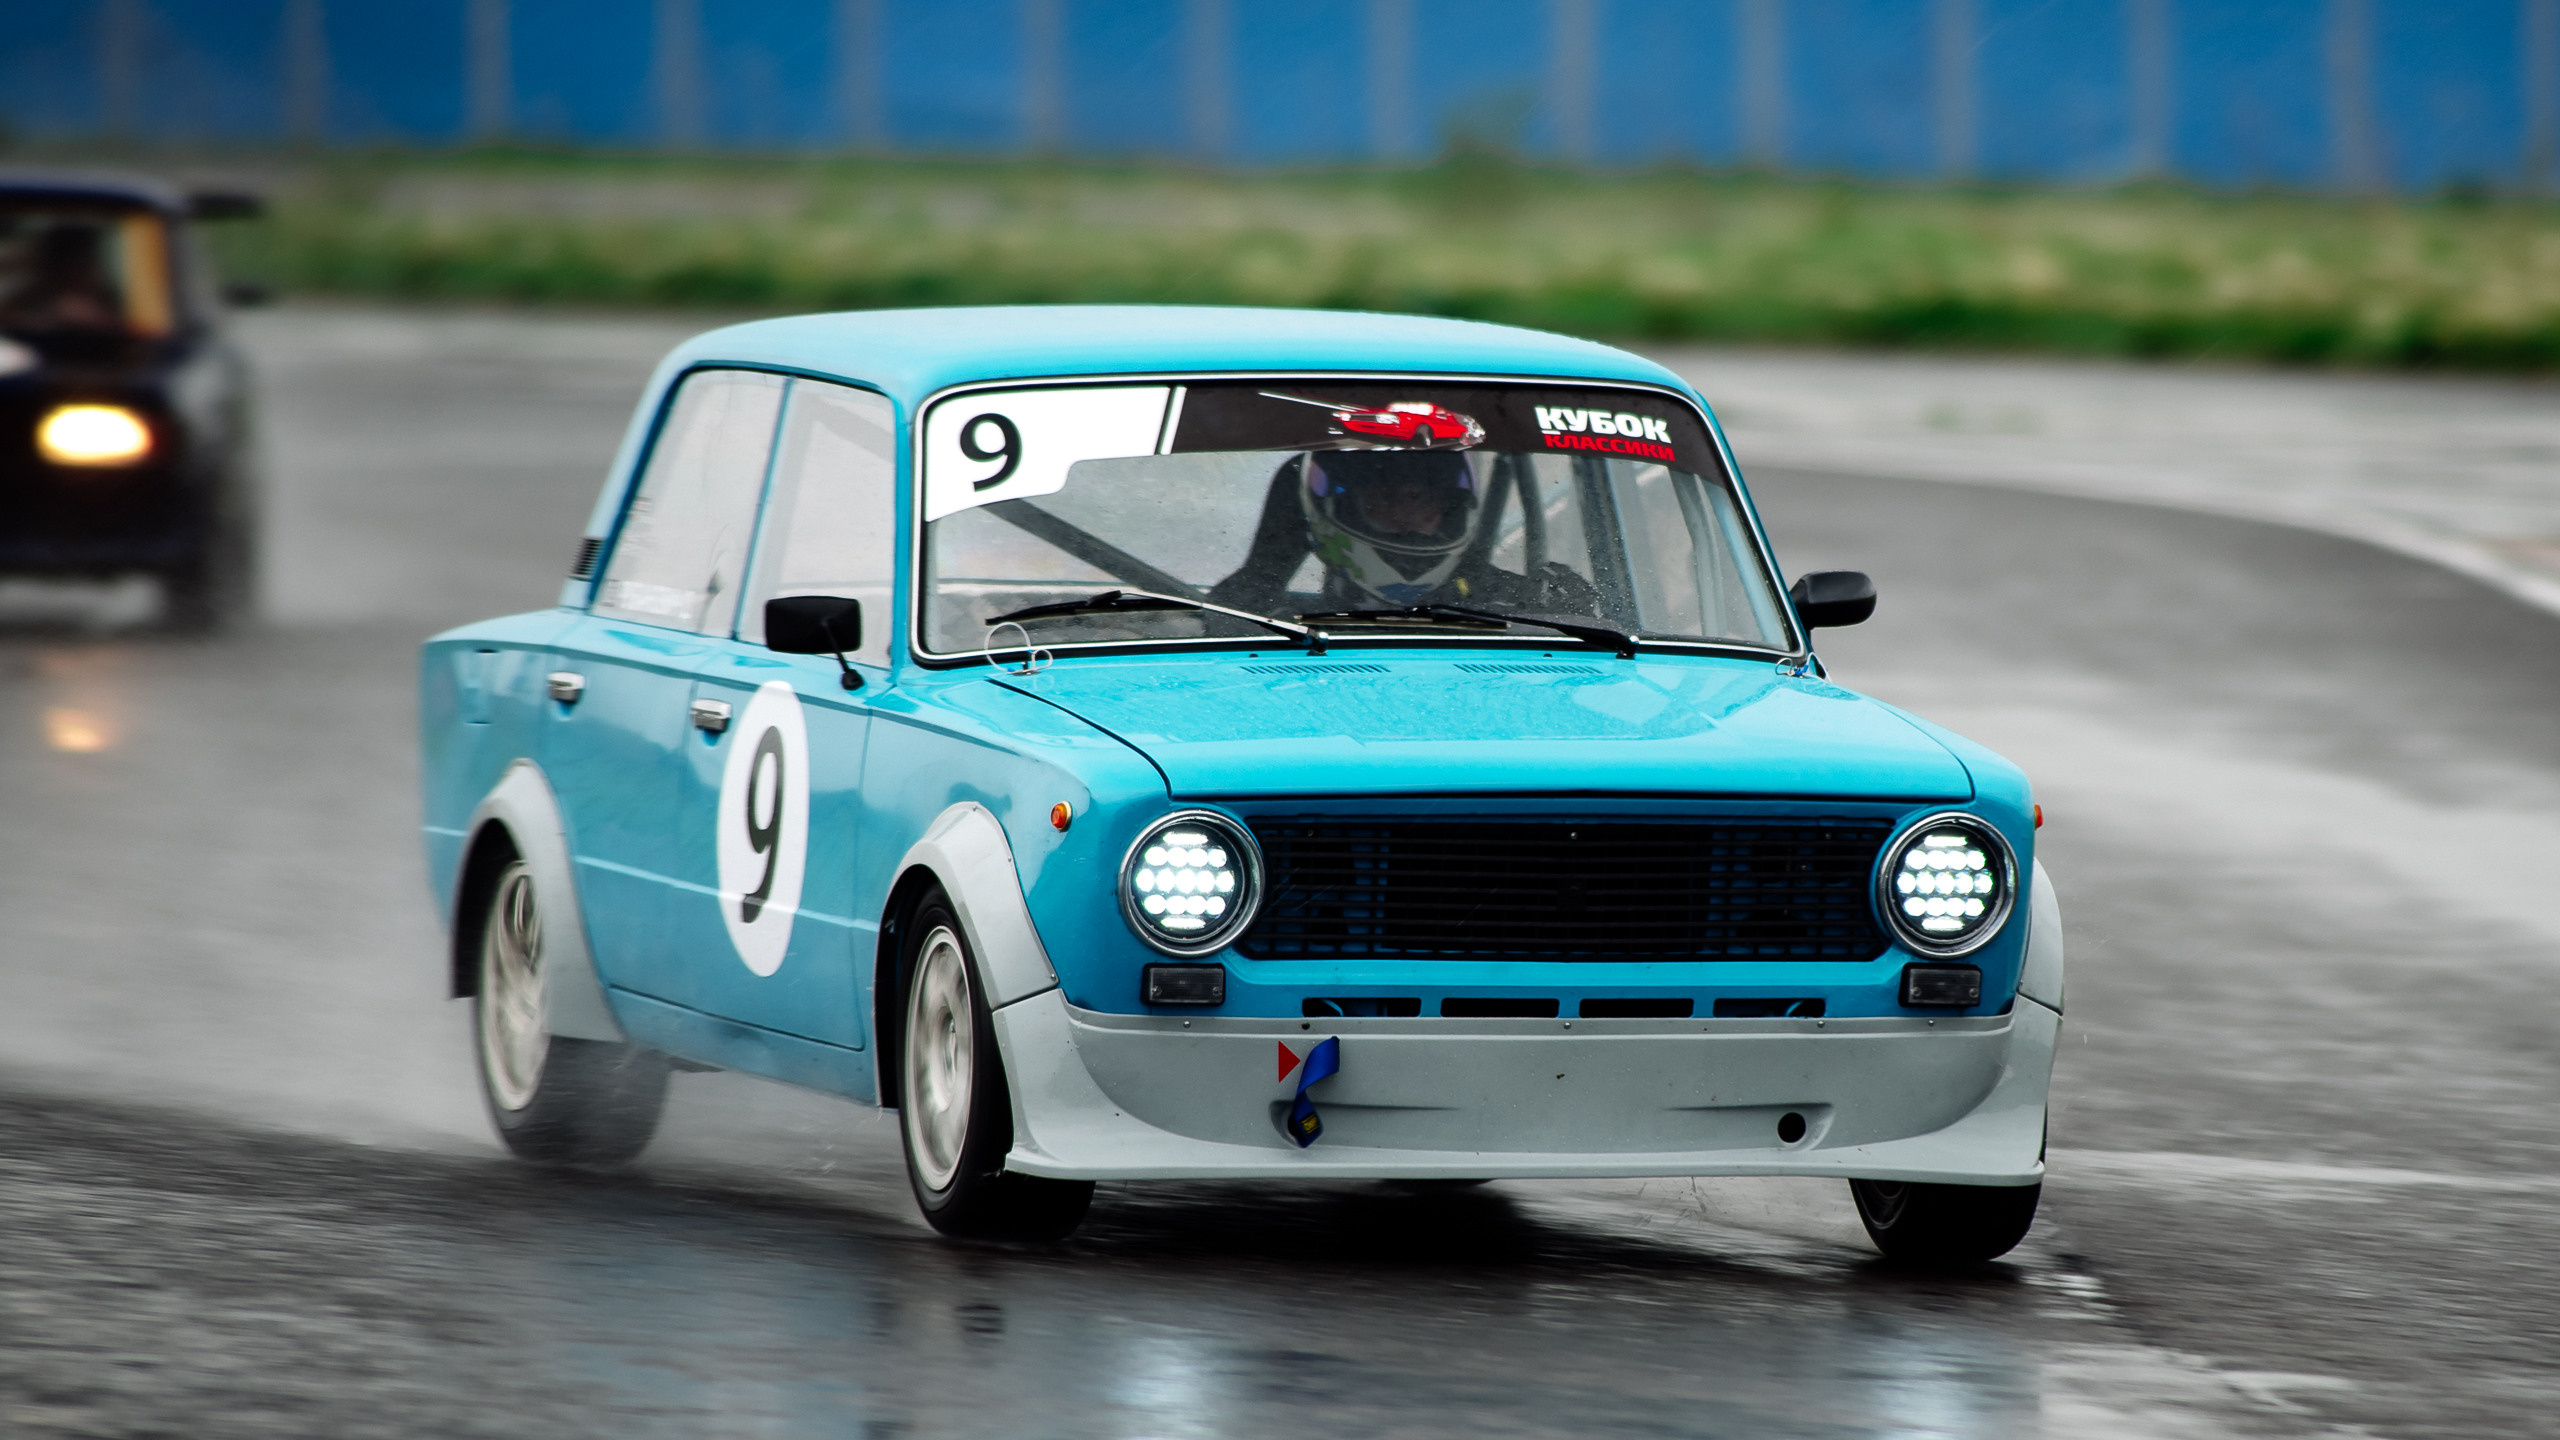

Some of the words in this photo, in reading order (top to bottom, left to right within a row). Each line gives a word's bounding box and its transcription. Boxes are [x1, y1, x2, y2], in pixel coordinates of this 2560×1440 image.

[959, 412, 1022, 492] 9
[1534, 405, 1672, 444] КУБОК
[1543, 433, 1676, 462] КЛАССИКИ
[740, 725, 785, 924] 9
